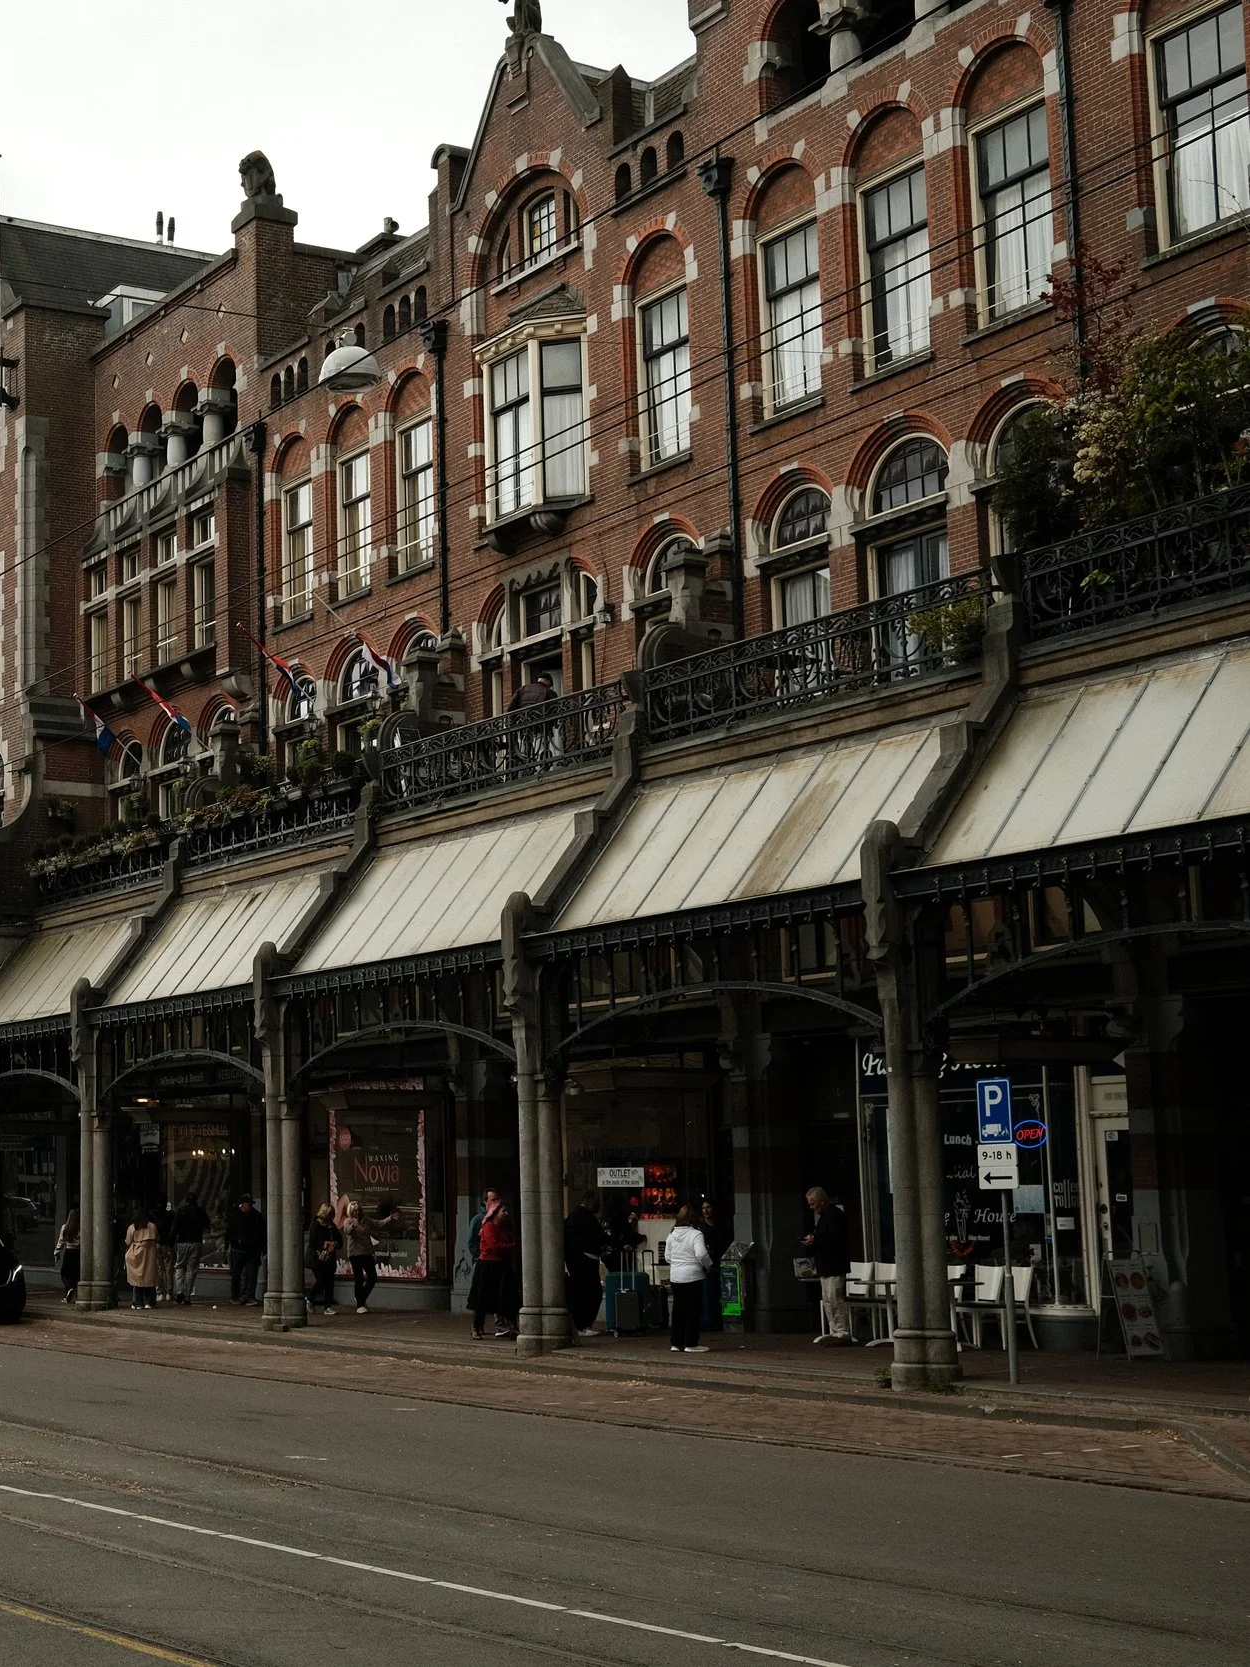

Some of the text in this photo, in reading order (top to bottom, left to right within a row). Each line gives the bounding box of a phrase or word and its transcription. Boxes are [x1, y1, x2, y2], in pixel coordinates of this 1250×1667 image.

[984, 1085, 1003, 1117] P
[944, 1134, 972, 1146] Lunch
[1017, 1128, 1044, 1141] OPEN
[368, 1154, 400, 1162] WAXING
[982, 1151, 1012, 1161] 9-18 h
[354, 1155, 400, 1183] Novia
[609, 1169, 631, 1178] OUTLET
[973, 1208, 1017, 1224] Houe
